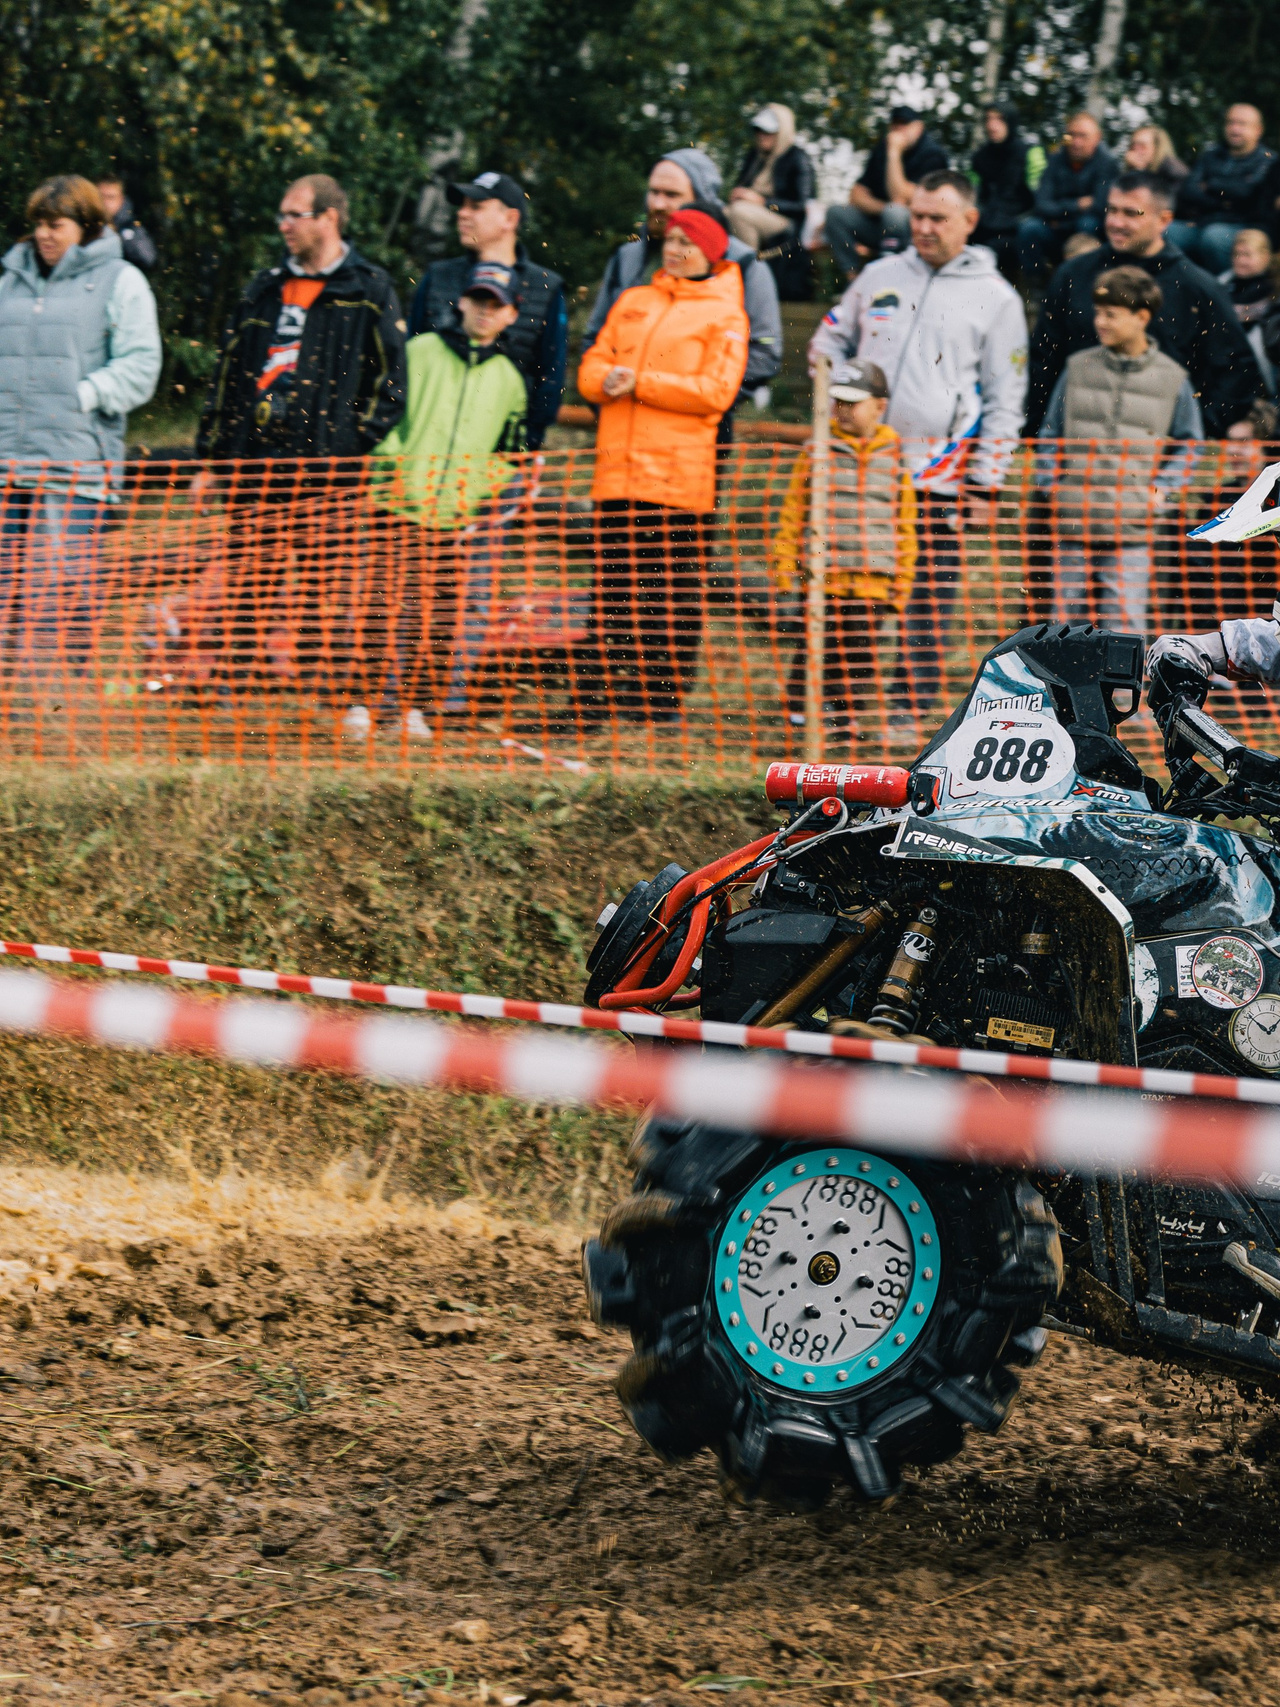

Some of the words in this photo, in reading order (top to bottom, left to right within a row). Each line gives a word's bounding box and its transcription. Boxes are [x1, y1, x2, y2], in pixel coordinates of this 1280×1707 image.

[801, 772, 863, 784] FIGHTER
[966, 736, 1054, 784] 888
[819, 1174, 879, 1216] 888
[1160, 1215, 1206, 1234] 4x4
[737, 1214, 779, 1280] 888
[869, 1256, 912, 1322] 888
[768, 1321, 830, 1363] 888
